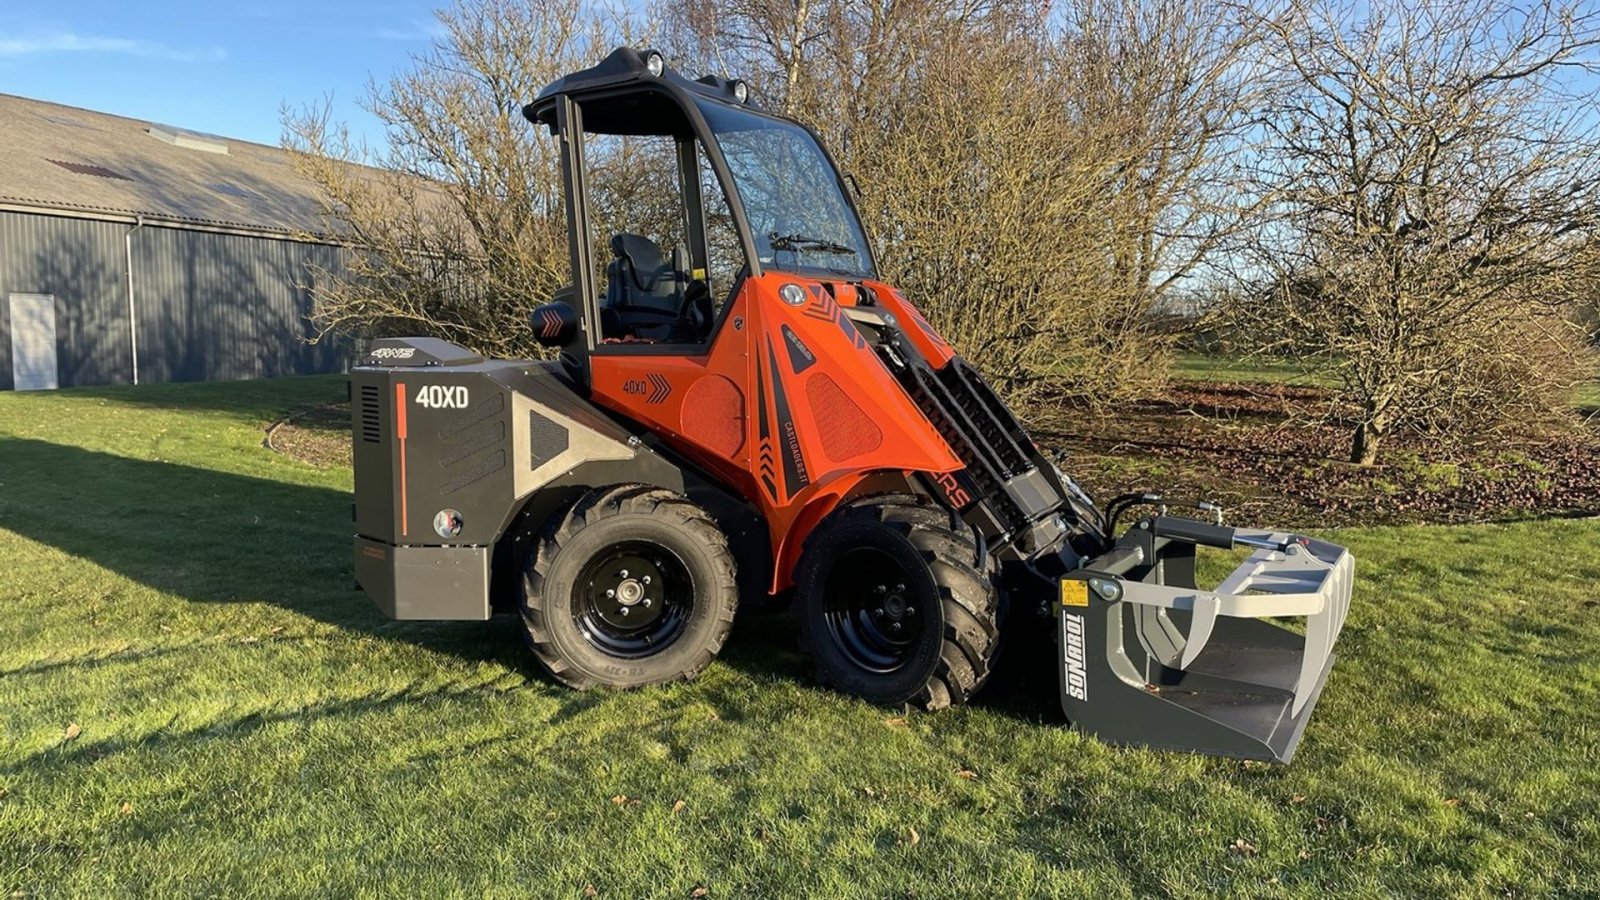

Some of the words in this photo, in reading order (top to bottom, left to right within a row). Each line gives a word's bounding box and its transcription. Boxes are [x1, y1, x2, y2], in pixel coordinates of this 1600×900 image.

[371, 348, 416, 358] 4WS
[415, 385, 469, 408] 40XD
[1064, 611, 1088, 701] SONAROL
